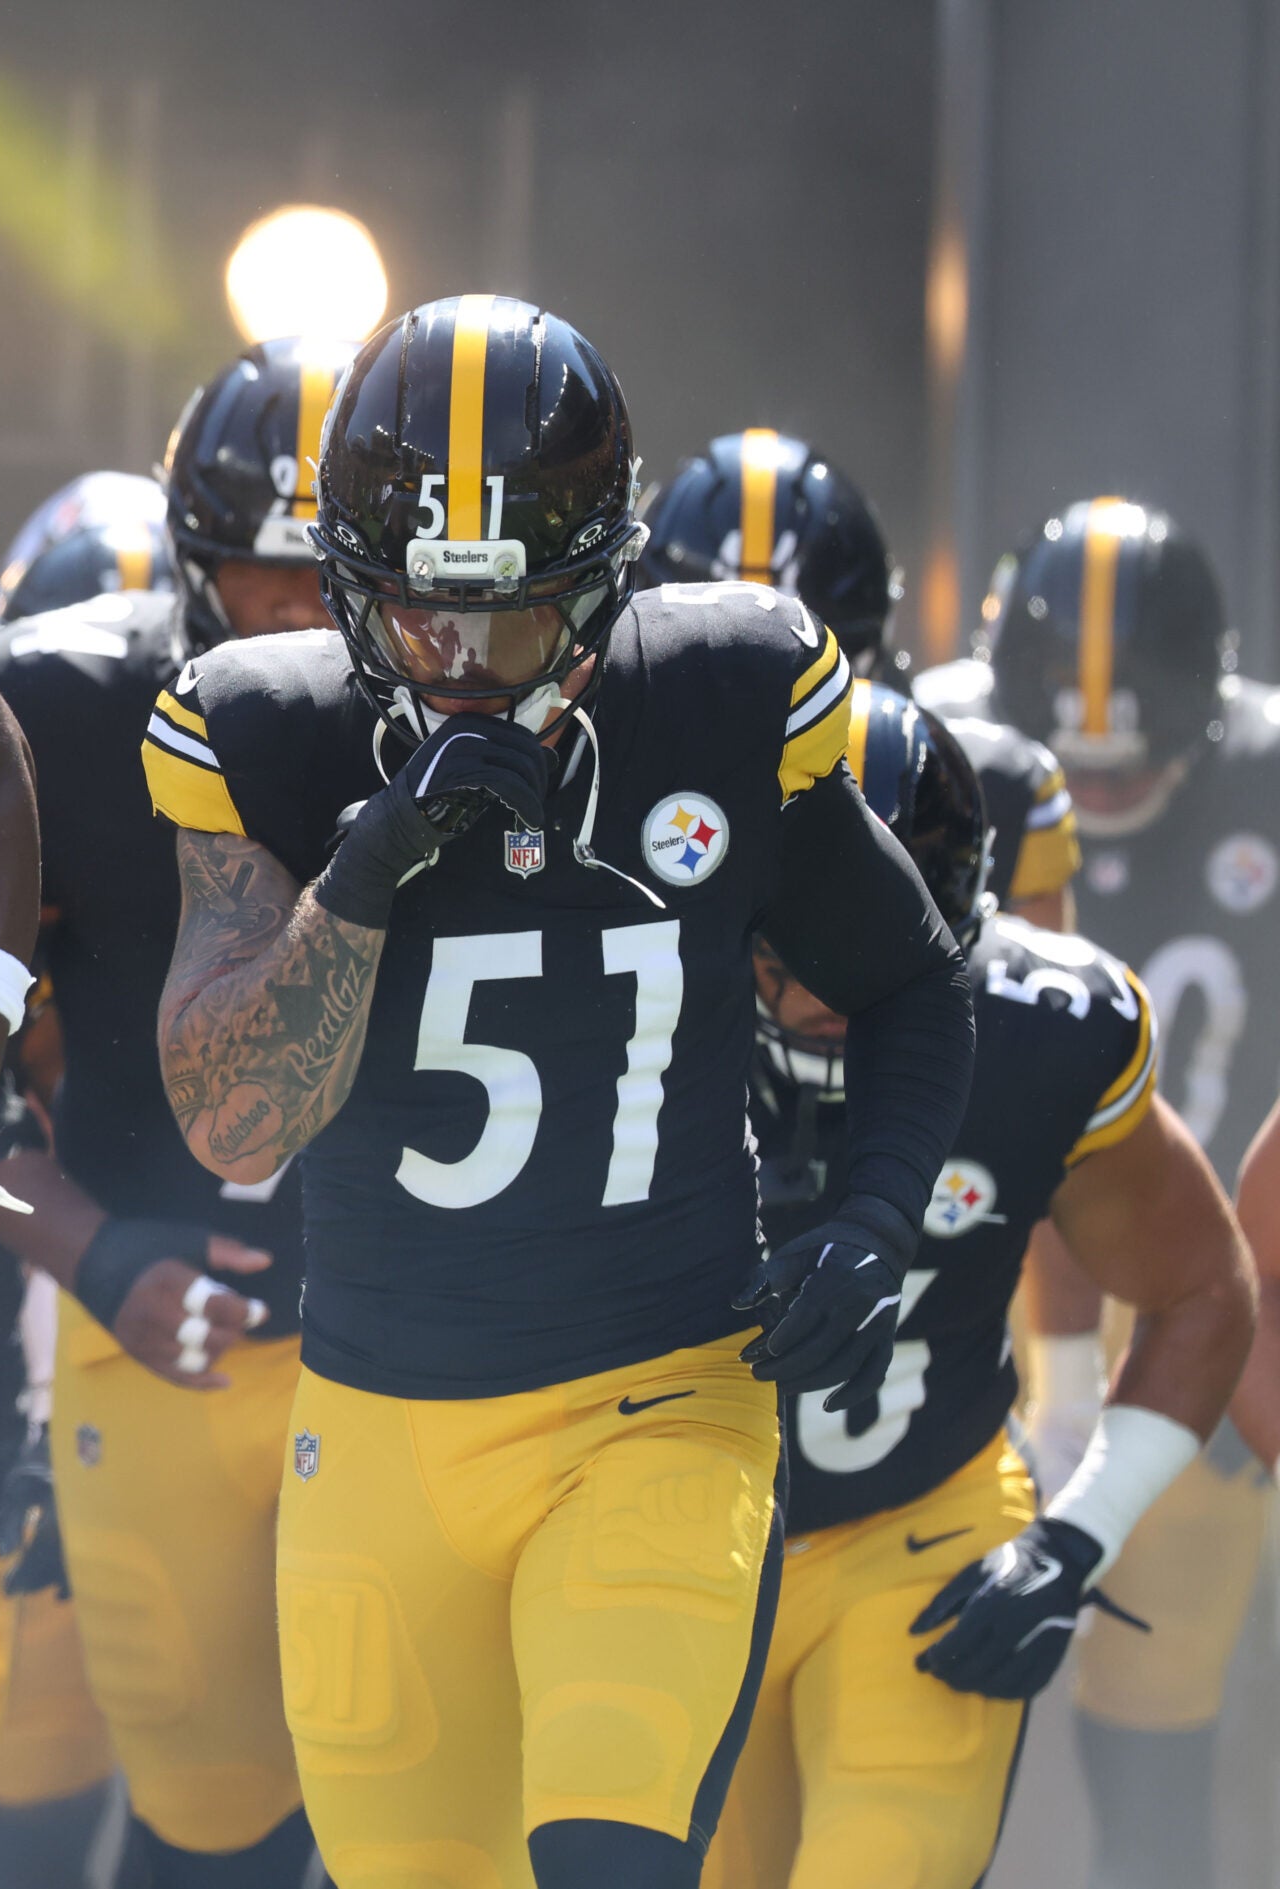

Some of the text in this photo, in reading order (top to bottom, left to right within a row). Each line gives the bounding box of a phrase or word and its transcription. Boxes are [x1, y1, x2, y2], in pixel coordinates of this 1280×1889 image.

[415, 474, 505, 540] 51
[571, 529, 608, 556] OAKLEY
[443, 550, 489, 564] Steelers
[651, 833, 686, 852] Steelers
[511, 847, 540, 869] NFL
[394, 919, 684, 1210] 51
[296, 1451, 315, 1472] NFL
